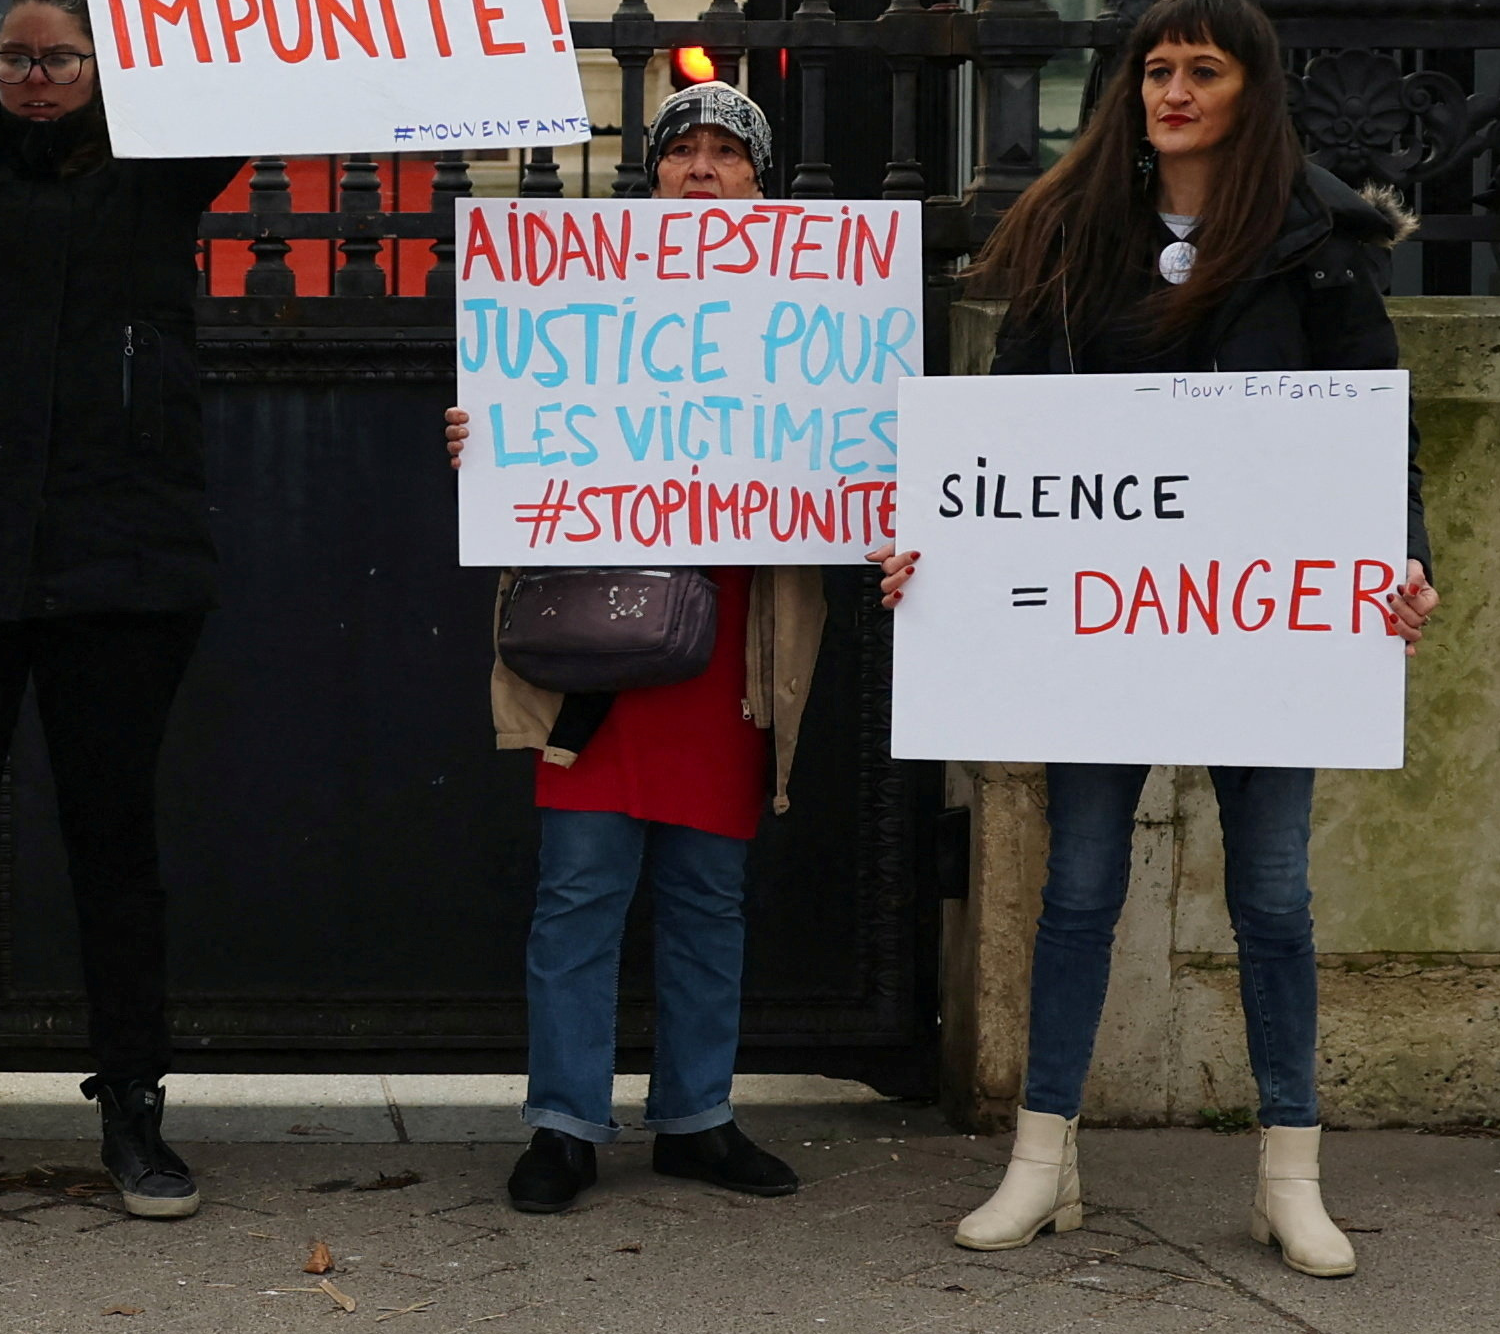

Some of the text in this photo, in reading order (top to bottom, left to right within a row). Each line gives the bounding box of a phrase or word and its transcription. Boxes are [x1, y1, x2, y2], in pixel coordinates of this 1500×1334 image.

[761, 301, 917, 383] POUR
[491, 402, 598, 469] LES
[1072, 559, 1400, 639] DANGER
